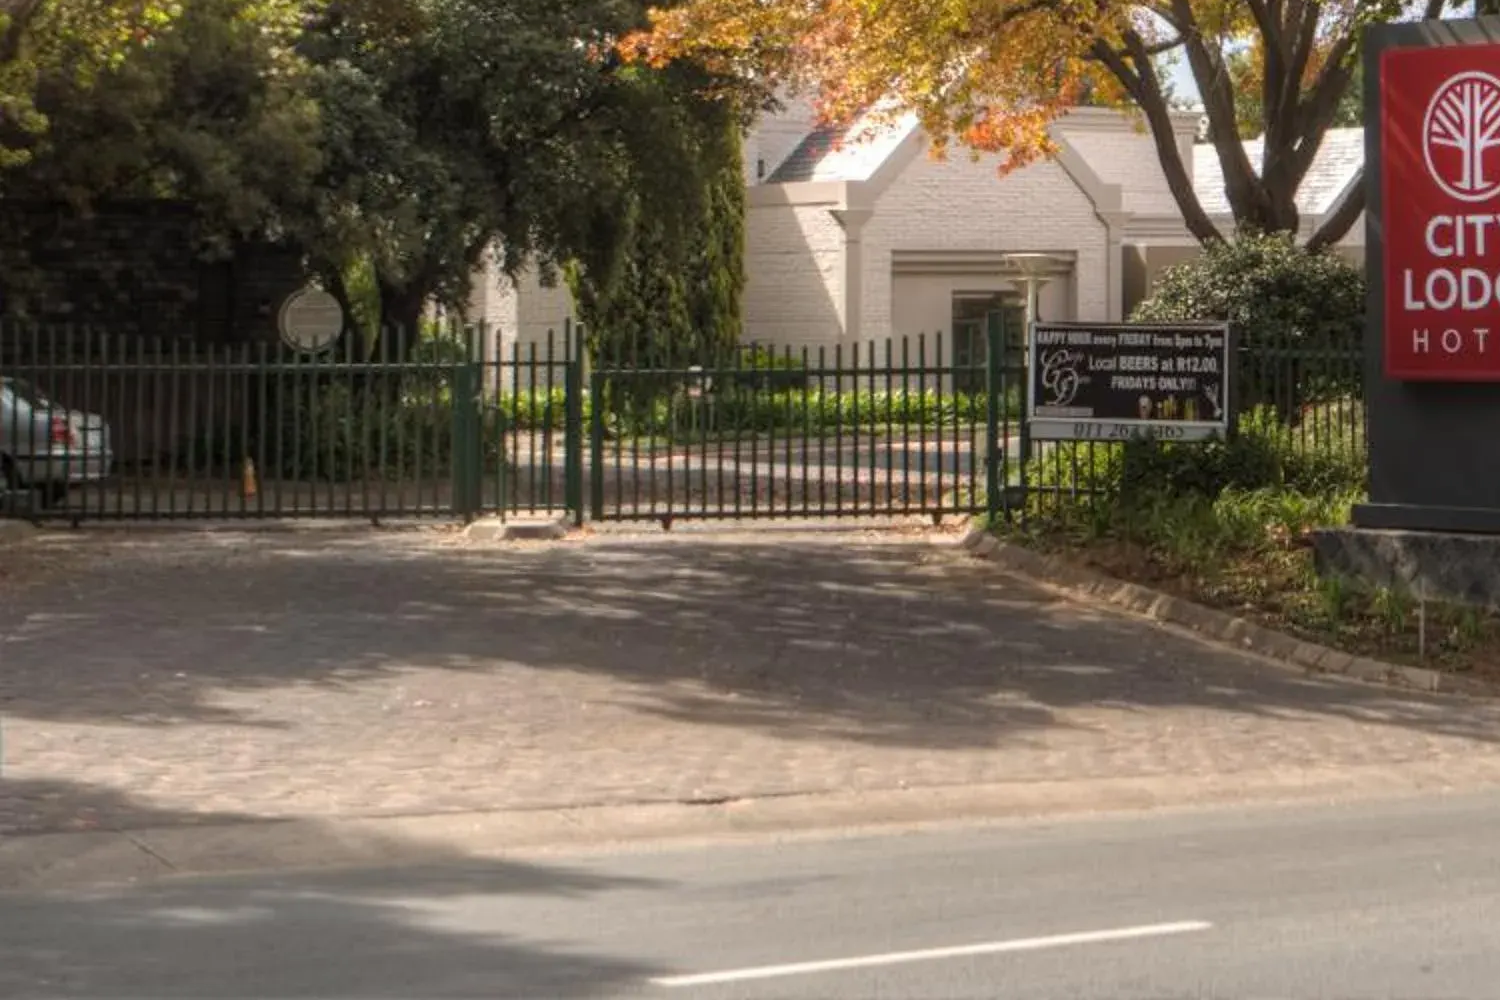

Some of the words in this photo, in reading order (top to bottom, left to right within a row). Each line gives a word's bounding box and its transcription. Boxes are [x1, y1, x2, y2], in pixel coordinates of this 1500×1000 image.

[1118, 332, 1152, 346] FRIDAY
[1088, 355, 1117, 371] Local
[1118, 355, 1159, 372] BEERS
[1161, 357, 1174, 372] at
[1111, 375, 1157, 391] FRIDAYS
